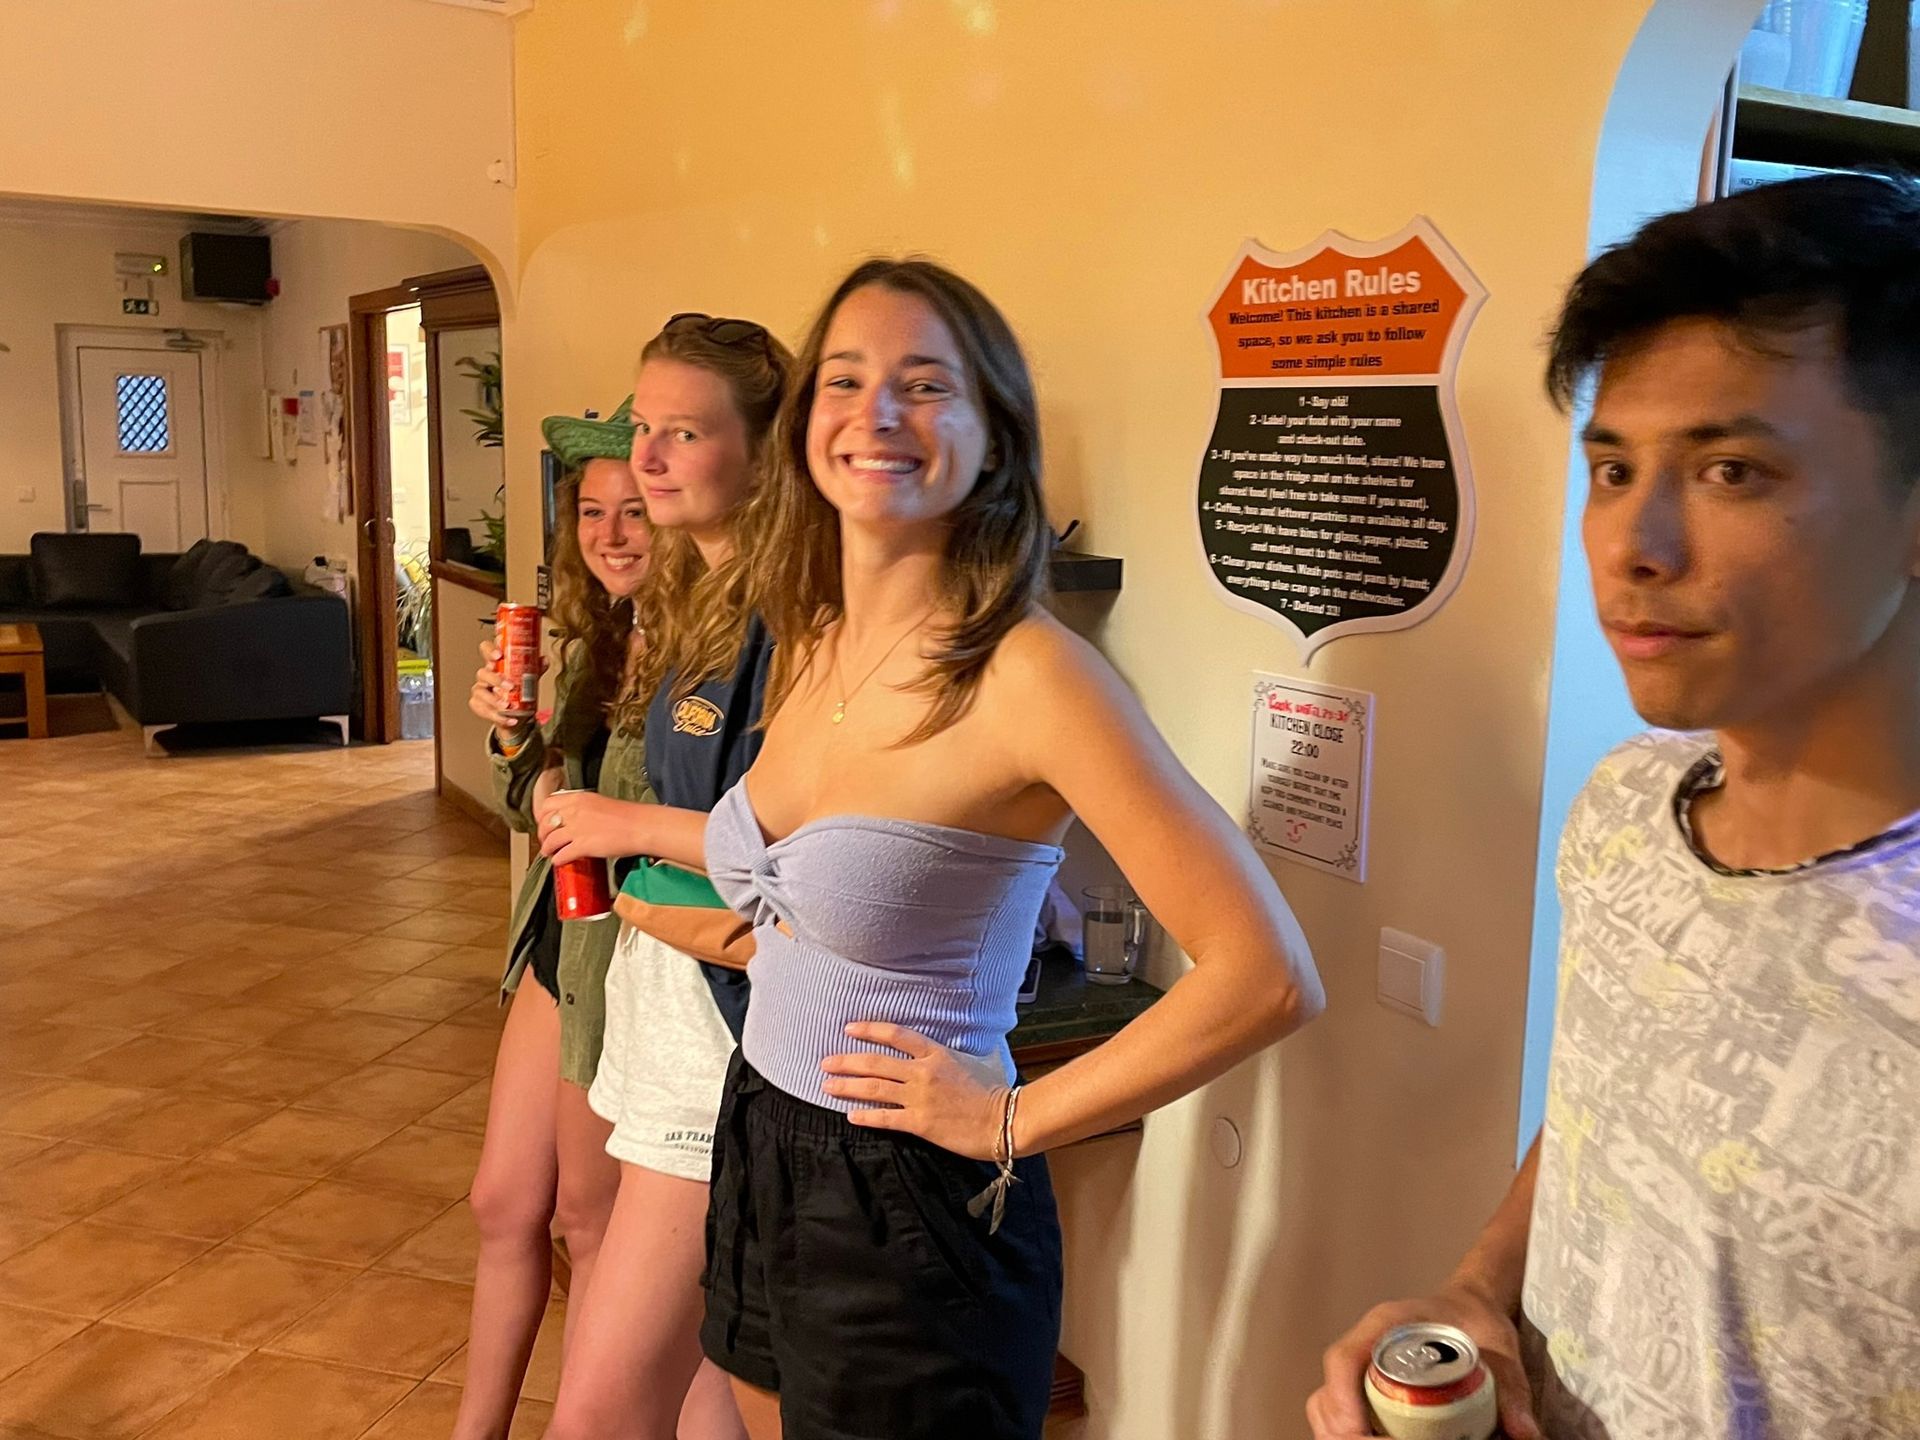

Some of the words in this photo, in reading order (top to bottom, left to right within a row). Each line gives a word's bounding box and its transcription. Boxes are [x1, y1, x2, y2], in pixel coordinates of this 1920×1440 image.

[1242, 275, 1337, 305] Kitchen
[1344, 266, 1421, 297] Rules
[1228, 306, 1284, 324] Welcome!
[1287, 307, 1312, 322] This
[1316, 305, 1361, 320] kitchen
[1366, 304, 1377, 316] is
[1381, 305, 1388, 316] a
[1392, 300, 1440, 314] shared
[1238, 335, 1276, 350] space,
[1279, 334, 1292, 346] so
[1296, 333, 1312, 345] we
[1316, 330, 1338, 344] ask
[1342, 332, 1364, 348] you
[1367, 329, 1381, 342] to
[1384, 327, 1428, 341] follow
[1272, 358, 1302, 370] some
[1305, 355, 1346, 371] simple
[1350, 354, 1382, 368] rules
[1286, 416, 1307, 428] your
[1308, 414, 1328, 426] food
[1330, 415, 1350, 426] with
[1350, 418, 1374, 429] your
[1374, 418, 1402, 428] name
[1278, 434, 1296, 444] and
[1296, 434, 1340, 446] check-out
[1258, 451, 1282, 462] made
[1283, 454, 1302, 465] way
[1302, 454, 1318, 464] too
[1319, 454, 1344, 464] much
[1402, 456, 1420, 468] We
[1420, 456, 1446, 470] have
[1232, 470, 1258, 480] space
[1260, 468, 1268, 480] in
[1270, 469, 1284, 480] the
[1285, 470, 1310, 484] fridge
[1311, 472, 1330, 482] and
[1330, 474, 1342, 484] on
[1342, 472, 1360, 484] the
[1360, 474, 1398, 486] shelves
[1399, 476, 1414, 488] for
[1307, 491, 1318, 501] to
[1319, 492, 1340, 502] take
[1340, 494, 1367, 504] some
[1368, 494, 1376, 504] if
[1376, 497, 1396, 508] you
[1260, 507, 1276, 516] and
[1276, 506, 1310, 520] leftover
[1350, 514, 1366, 524] are
[1367, 514, 1410, 528] available
[1411, 517, 1426, 529] all
[1278, 525, 1299, 537] have
[1299, 527, 1319, 538] bins
[1319, 528, 1332, 540] for
[1394, 536, 1430, 549] plastic
[1250, 542, 1268, 552] and
[1268, 544, 1294, 554] metal
[1315, 548, 1326, 558] to
[1326, 549, 1343, 560] the
[1245, 560, 1266, 571] your
[1296, 564, 1322, 576] Wash
[1322, 569, 1344, 581] pots
[1344, 570, 1362, 582] and
[1363, 574, 1388, 586] pans
[1388, 574, 1400, 588] by
[1226, 576, 1270, 590] everything
[1290, 584, 1308, 594] can
[1308, 587, 1321, 597] go
[1321, 586, 1331, 596] in
[1332, 588, 1348, 599] the
[1270, 712, 1310, 736] KITCHEN
[1313, 723, 1344, 744] CLOSE
[1291, 740, 1320, 758] 22:00
[664, 1131, 683, 1142] SAN
